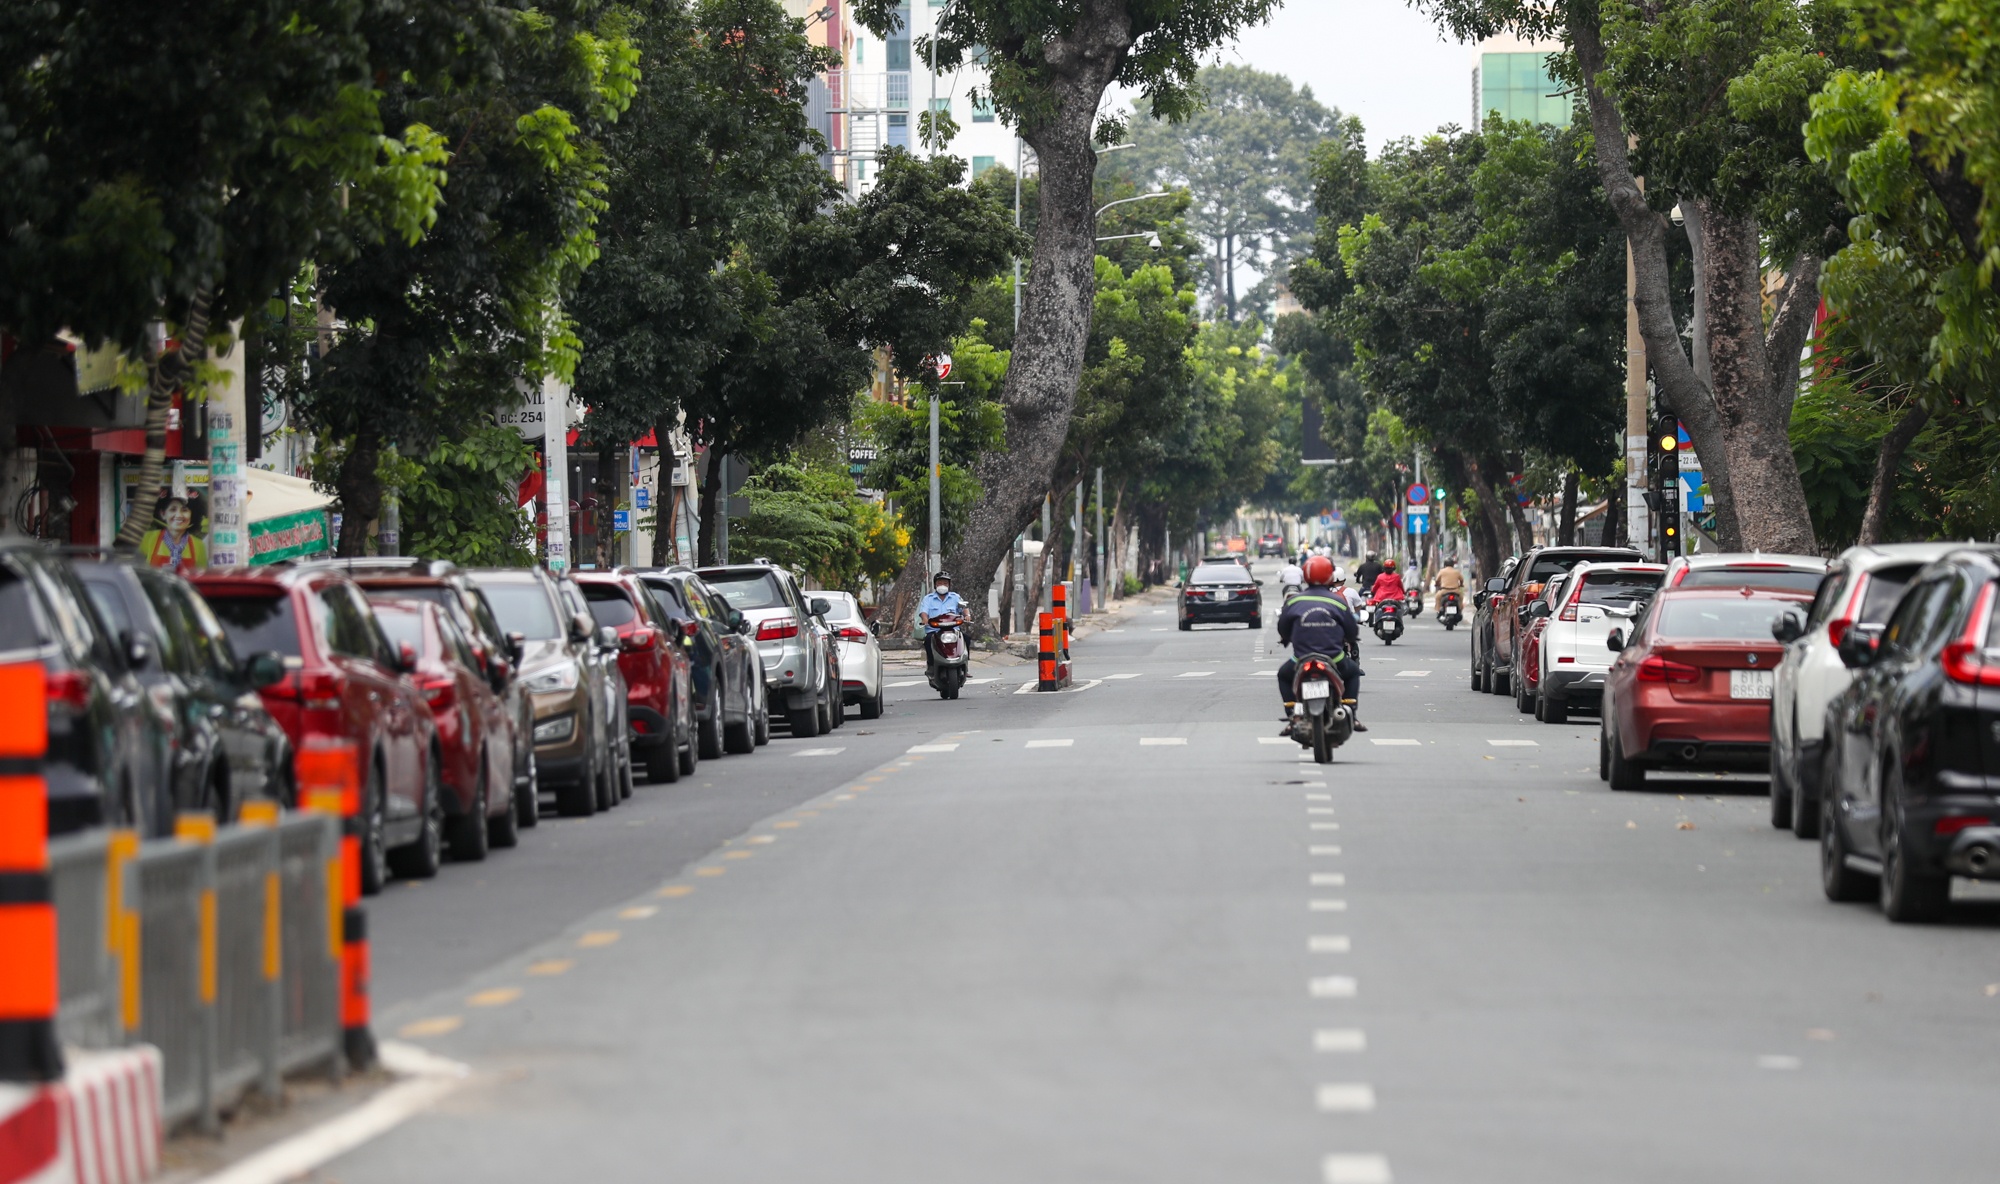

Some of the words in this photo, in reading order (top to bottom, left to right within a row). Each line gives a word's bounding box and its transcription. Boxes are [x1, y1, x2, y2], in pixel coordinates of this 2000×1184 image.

[501, 414, 517, 424] ĐC:
[521, 412, 546, 423] 254
[1741, 670, 1763, 684] 61A
